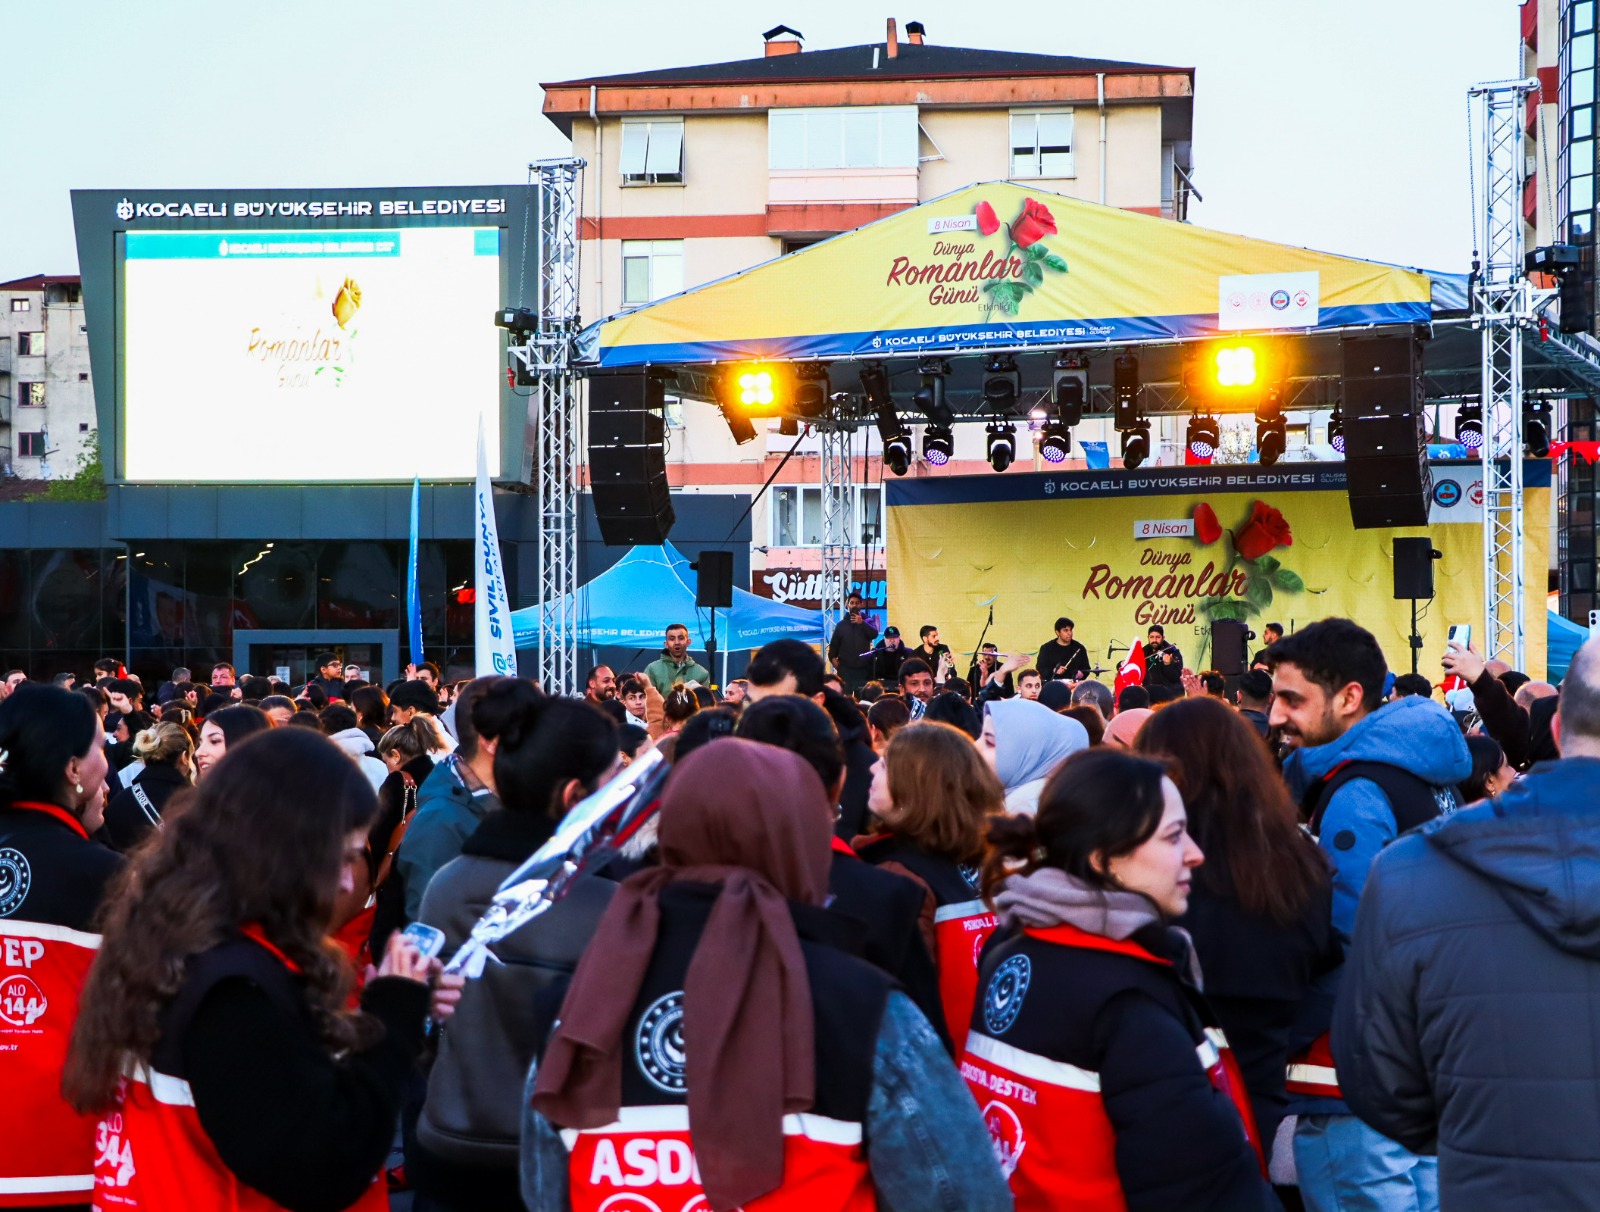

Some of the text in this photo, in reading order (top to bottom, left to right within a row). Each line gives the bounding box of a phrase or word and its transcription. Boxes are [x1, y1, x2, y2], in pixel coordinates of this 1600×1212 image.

[136, 199, 506, 218] KOCAELİ BÜYÜKŞEHİR BELEDİYESİ
[934, 219, 971, 230] 8 Nisan
[933, 241, 975, 261] Dünya
[887, 250, 1023, 286] Romanlar
[929, 285, 979, 305] Günü
[885, 335, 935, 346] KOCAELİ
[1061, 480, 1123, 491] KOCAELİ
[1142, 523, 1188, 534] 8 Nisan
[1140, 548, 1191, 573] Dünya
[1082, 561, 1248, 599] Romanlar
[1134, 600, 1195, 625] Günü
[0, 937, 45, 969] EP
[8, 984, 27, 996] ALO
[990, 1074, 1037, 1105] DESTEK
[589, 1138, 702, 1187] ASD
